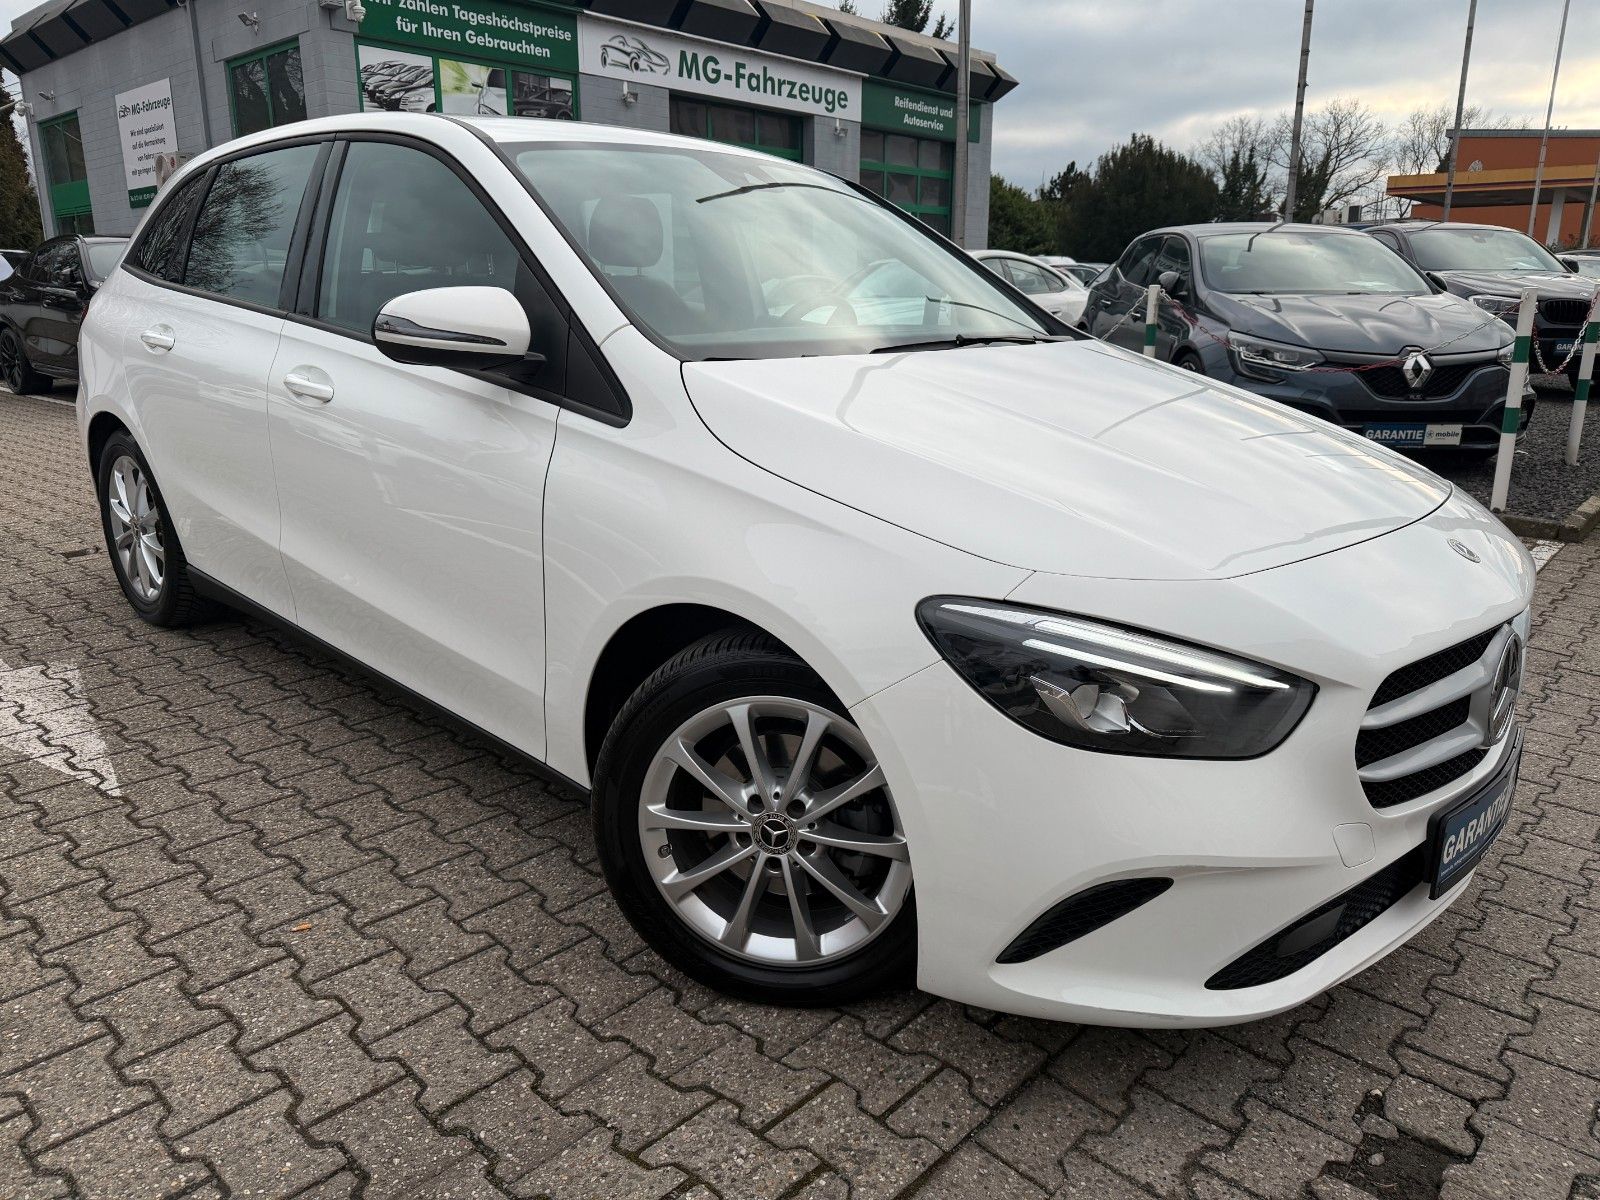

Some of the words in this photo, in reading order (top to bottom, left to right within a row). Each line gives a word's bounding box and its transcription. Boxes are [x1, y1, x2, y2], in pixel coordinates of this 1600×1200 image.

[396, 15, 418, 34] für
[422, 21, 461, 41] Ihren
[465, 29, 551, 58] Gebrauchten
[452, 4, 572, 41] Tageshöchstpreise
[678, 50, 848, 113] MG-Fahrzeuge
[894, 95, 939, 115] Reifendienst
[939, 107, 954, 119] und
[903, 113, 944, 131] Autoservice
[1365, 429, 1424, 440] GARANTIE
[1442, 786, 1508, 865] GARANTIE
